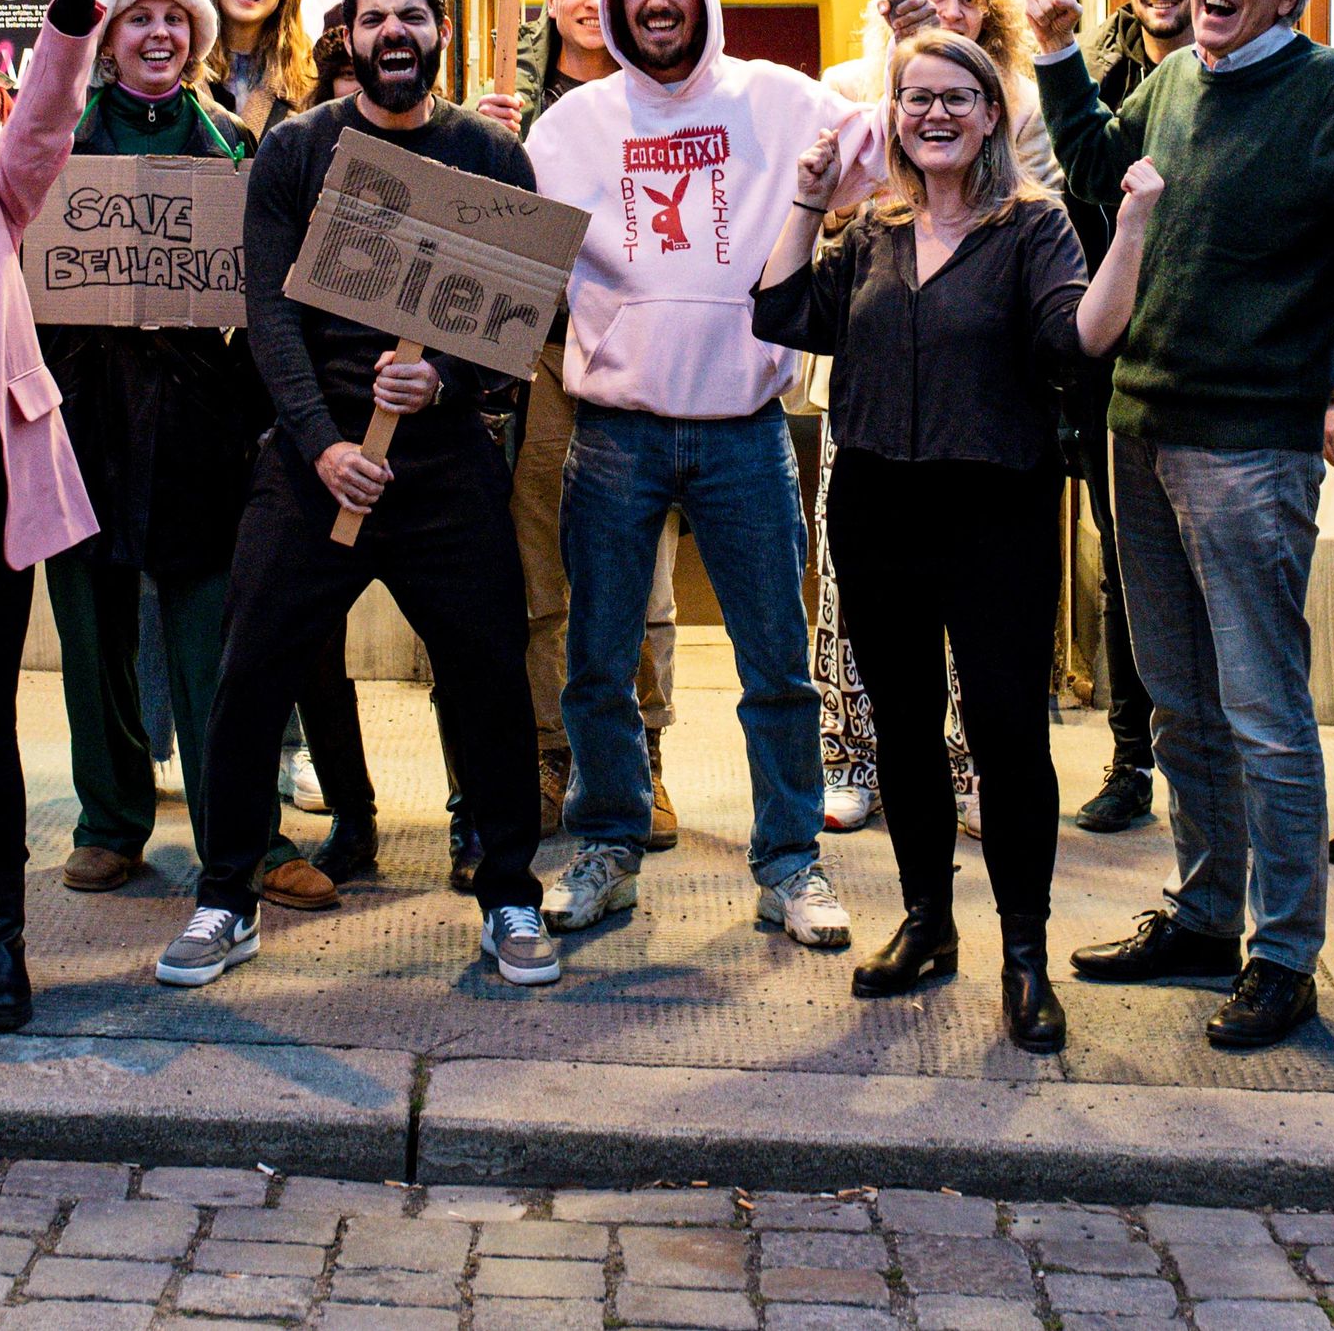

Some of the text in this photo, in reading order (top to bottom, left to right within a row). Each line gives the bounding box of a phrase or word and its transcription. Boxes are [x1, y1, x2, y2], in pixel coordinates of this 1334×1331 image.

[63, 187, 193, 243] SAVE
[307, 157, 540, 345] Bier
[449, 196, 539, 224] Bitte
[620, 176, 639, 263] BEST
[710, 169, 731, 265] PRICE
